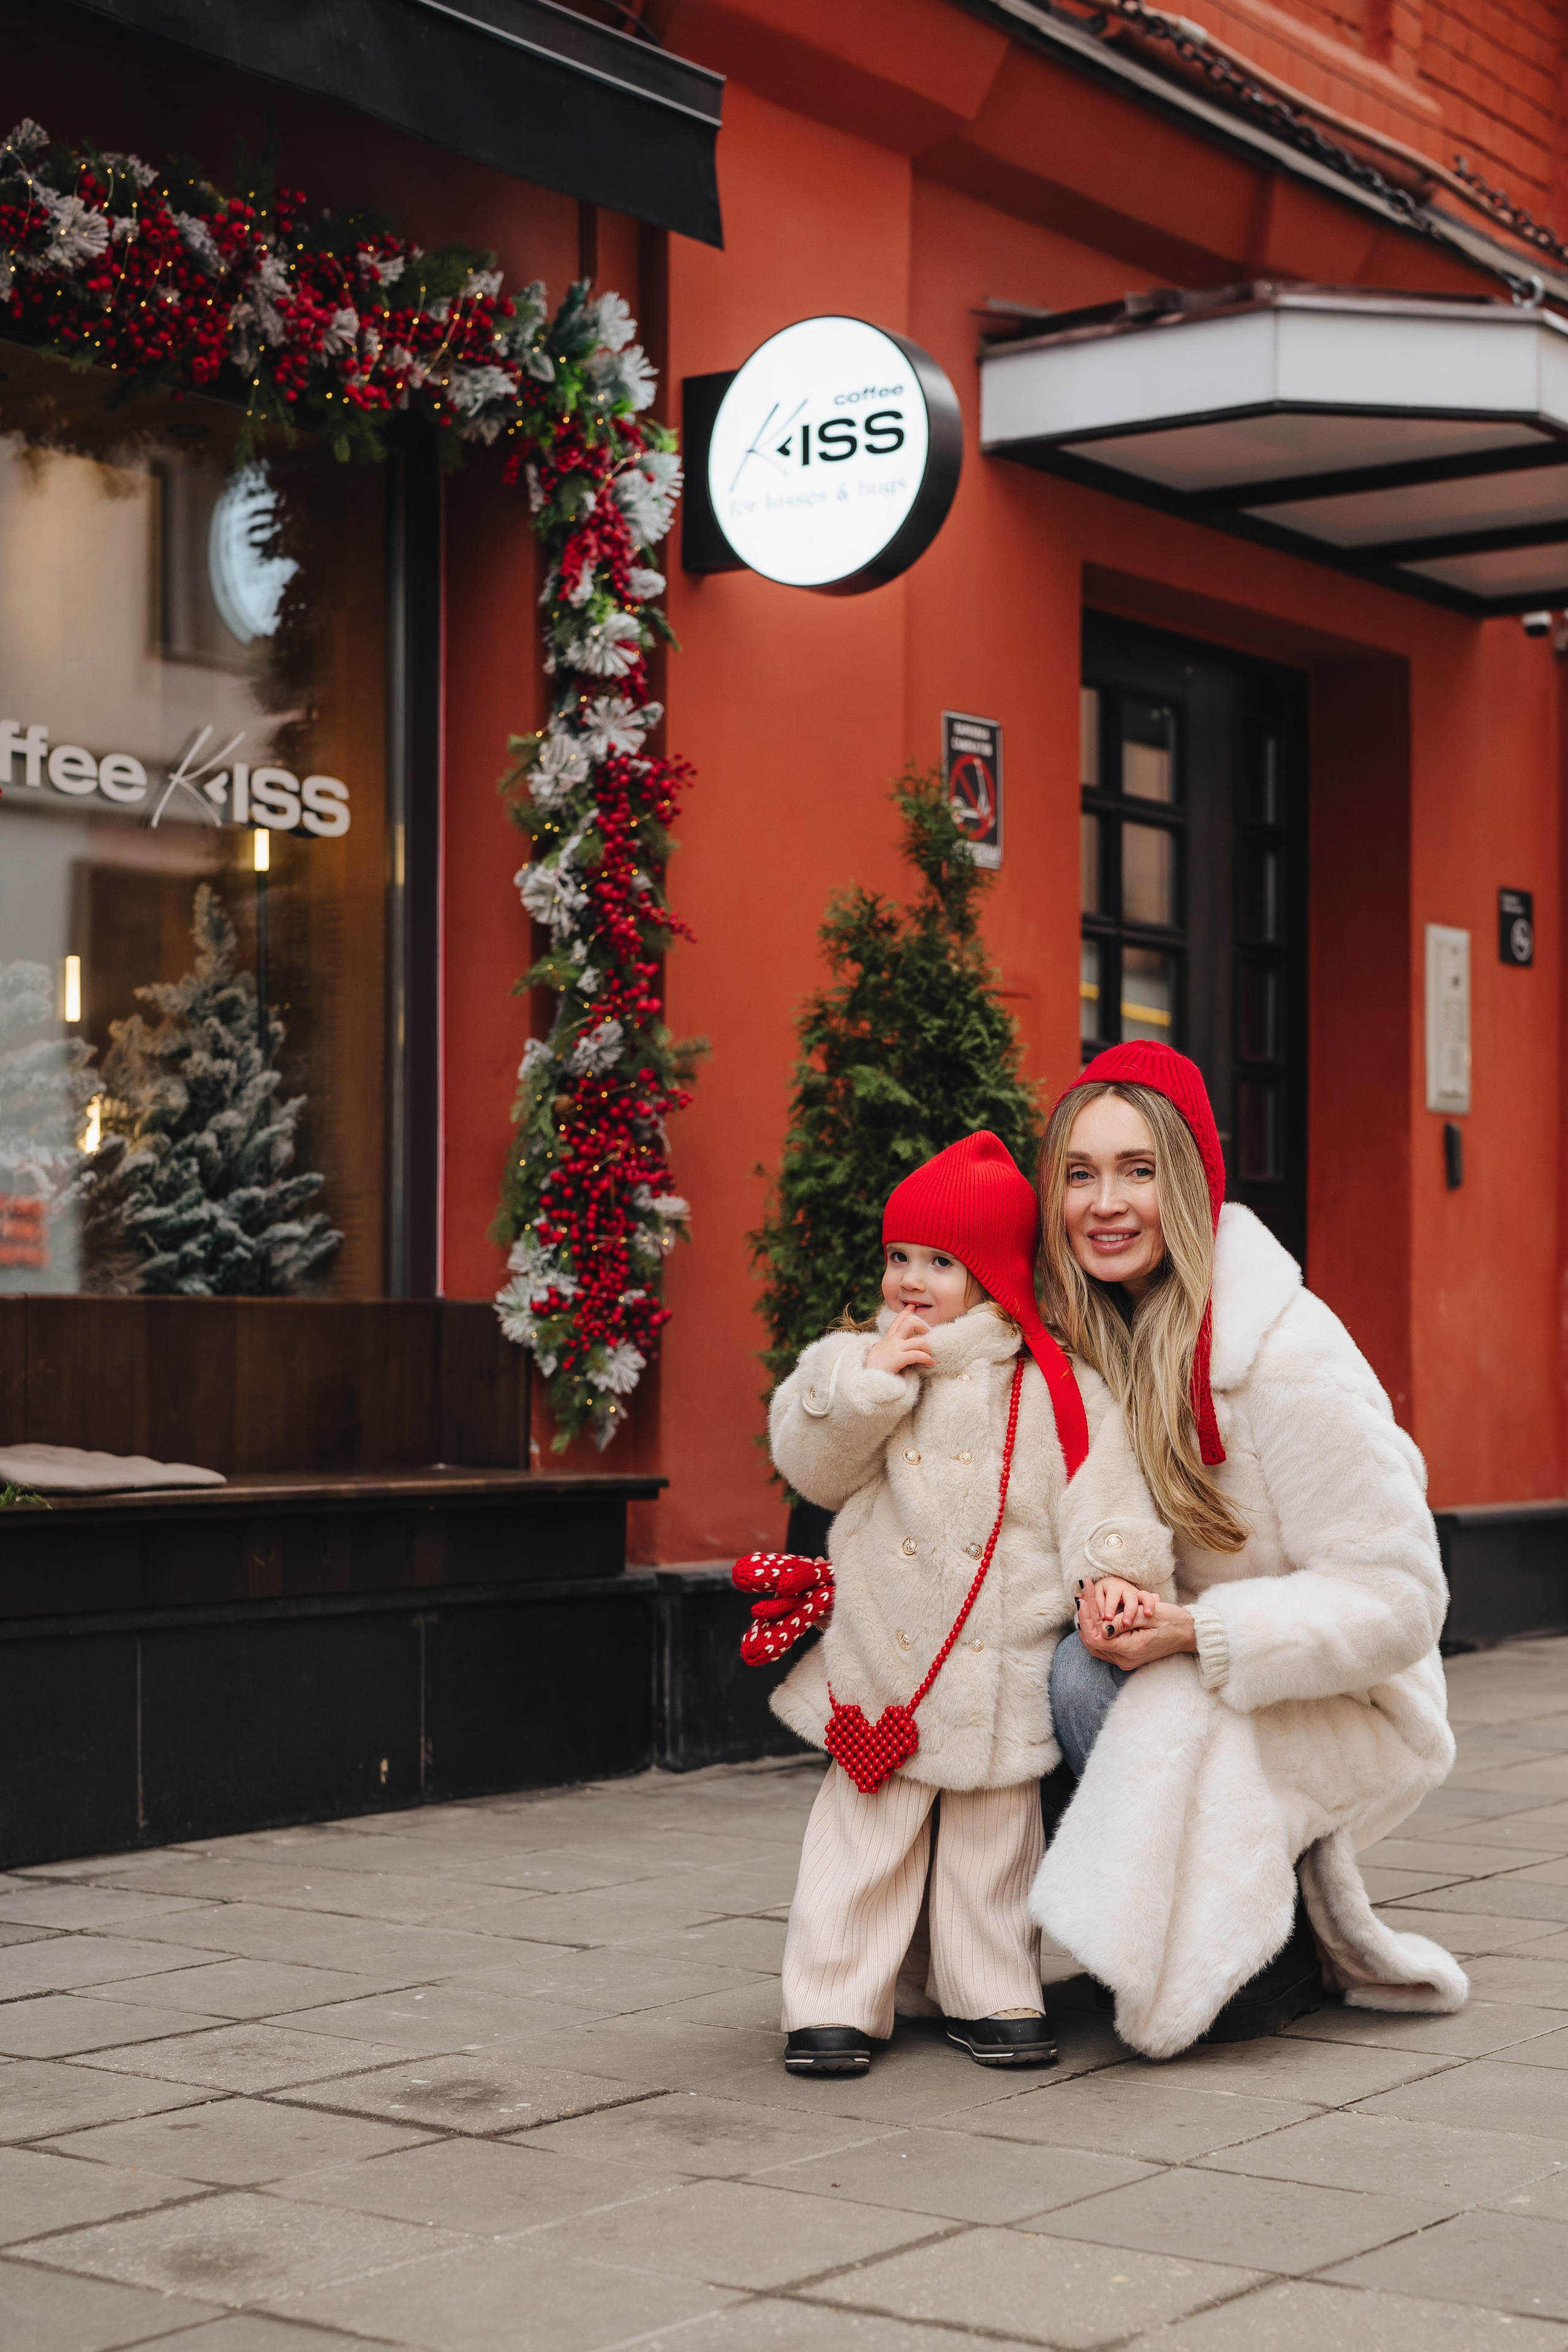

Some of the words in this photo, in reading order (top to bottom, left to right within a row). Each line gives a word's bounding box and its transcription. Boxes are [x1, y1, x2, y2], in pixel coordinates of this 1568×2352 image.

[834, 385, 904, 405] coffee
[729, 398, 905, 492] KISS
[151, 723, 351, 838] KISS
